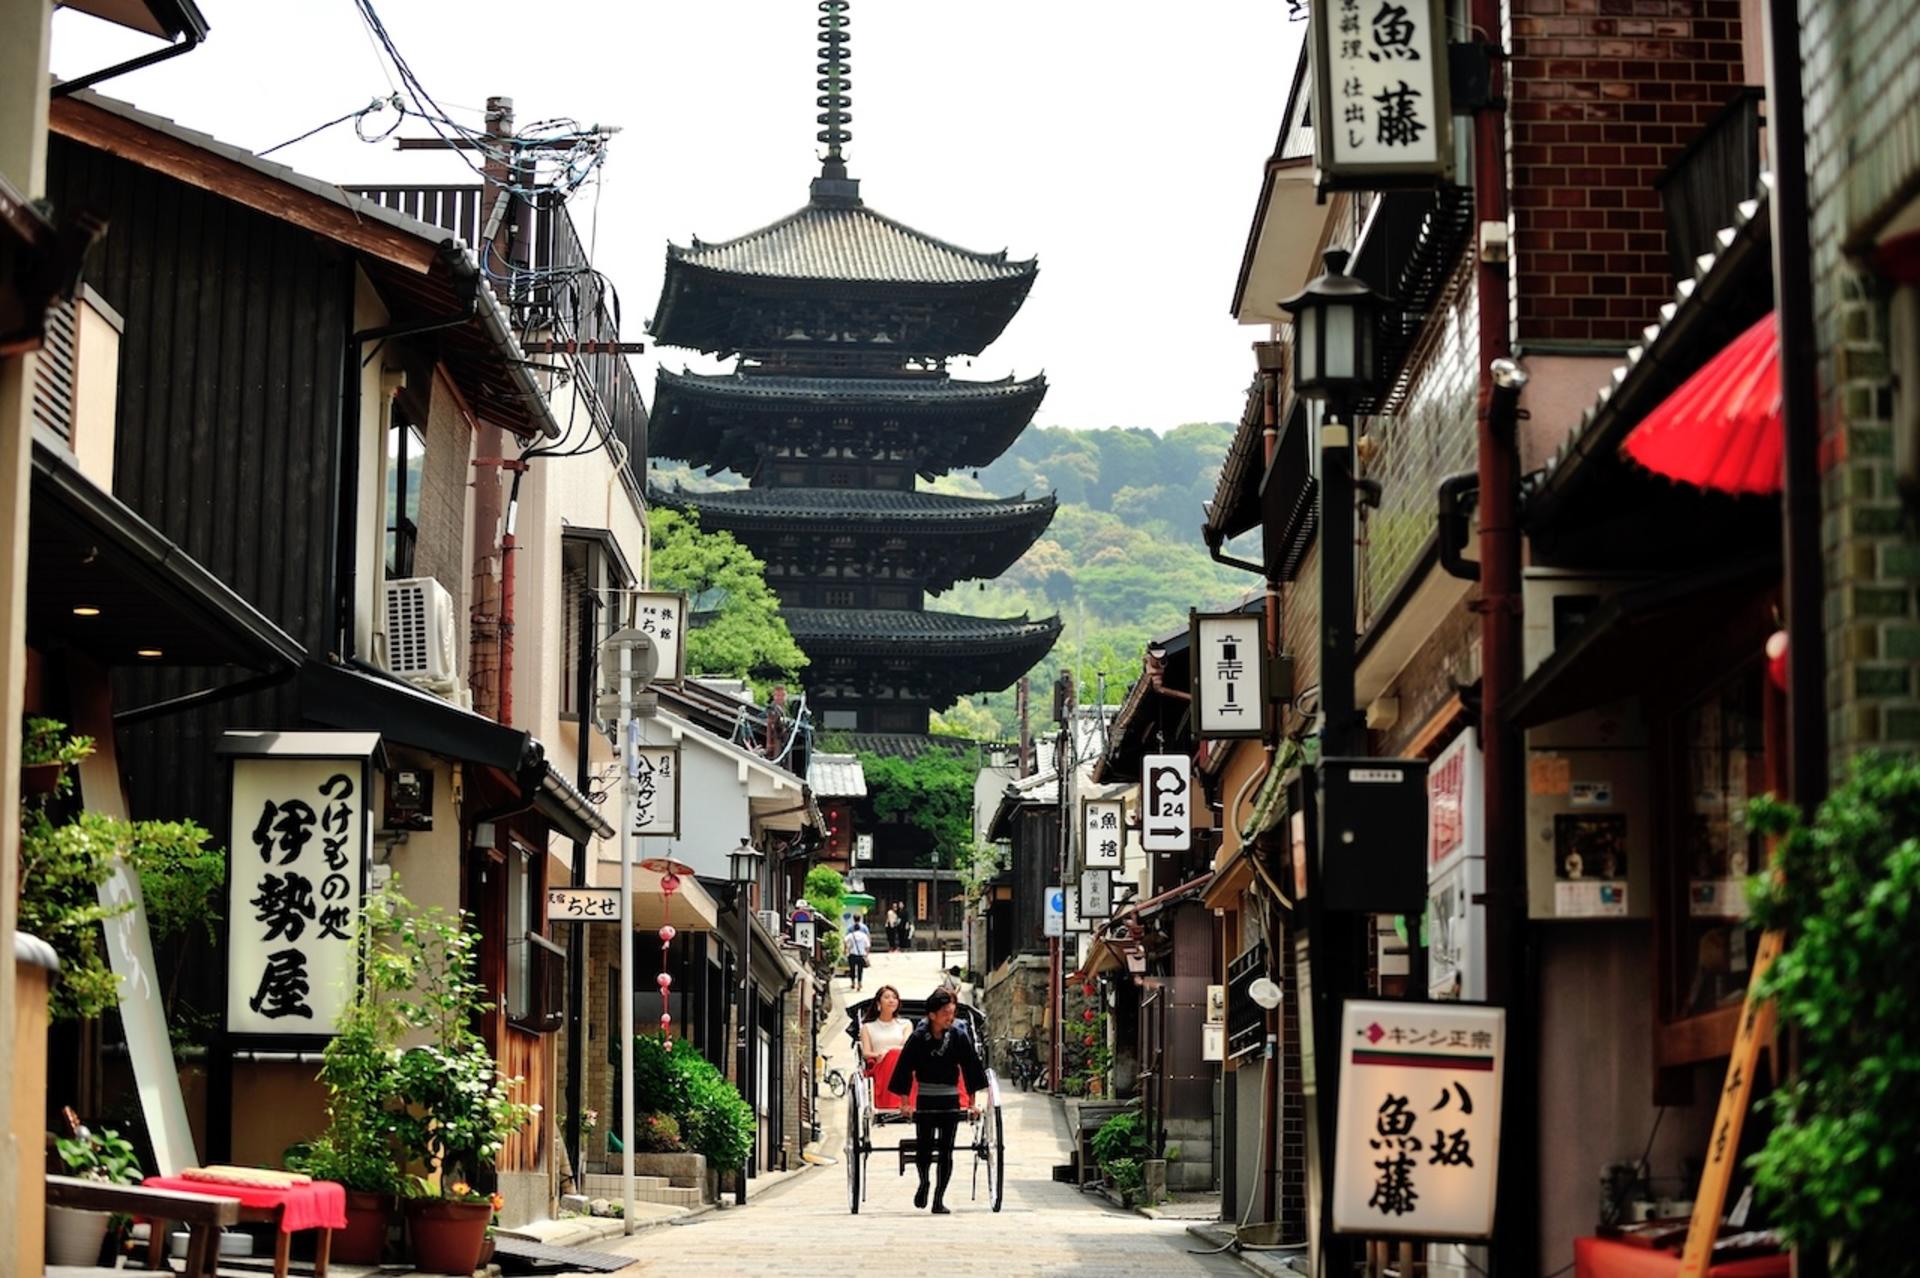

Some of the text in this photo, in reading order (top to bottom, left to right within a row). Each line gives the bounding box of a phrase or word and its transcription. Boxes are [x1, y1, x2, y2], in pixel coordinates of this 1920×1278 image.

[1367, 1, 1427, 147] 魚藤
[660, 608, 673, 639] 旅館
[636, 754, 656, 828] 八坂ガレージ
[1162, 802, 1185, 817] 24
[317, 774, 353, 940] つけもの処
[249, 799, 318, 1020] 伊勢屋
[568, 896, 616, 916] ちとせ
[1388, 1026, 1492, 1049] キンシ正宗
[1368, 1093, 1422, 1216] 魚藤
[1428, 1081, 1474, 1168] 八坂
